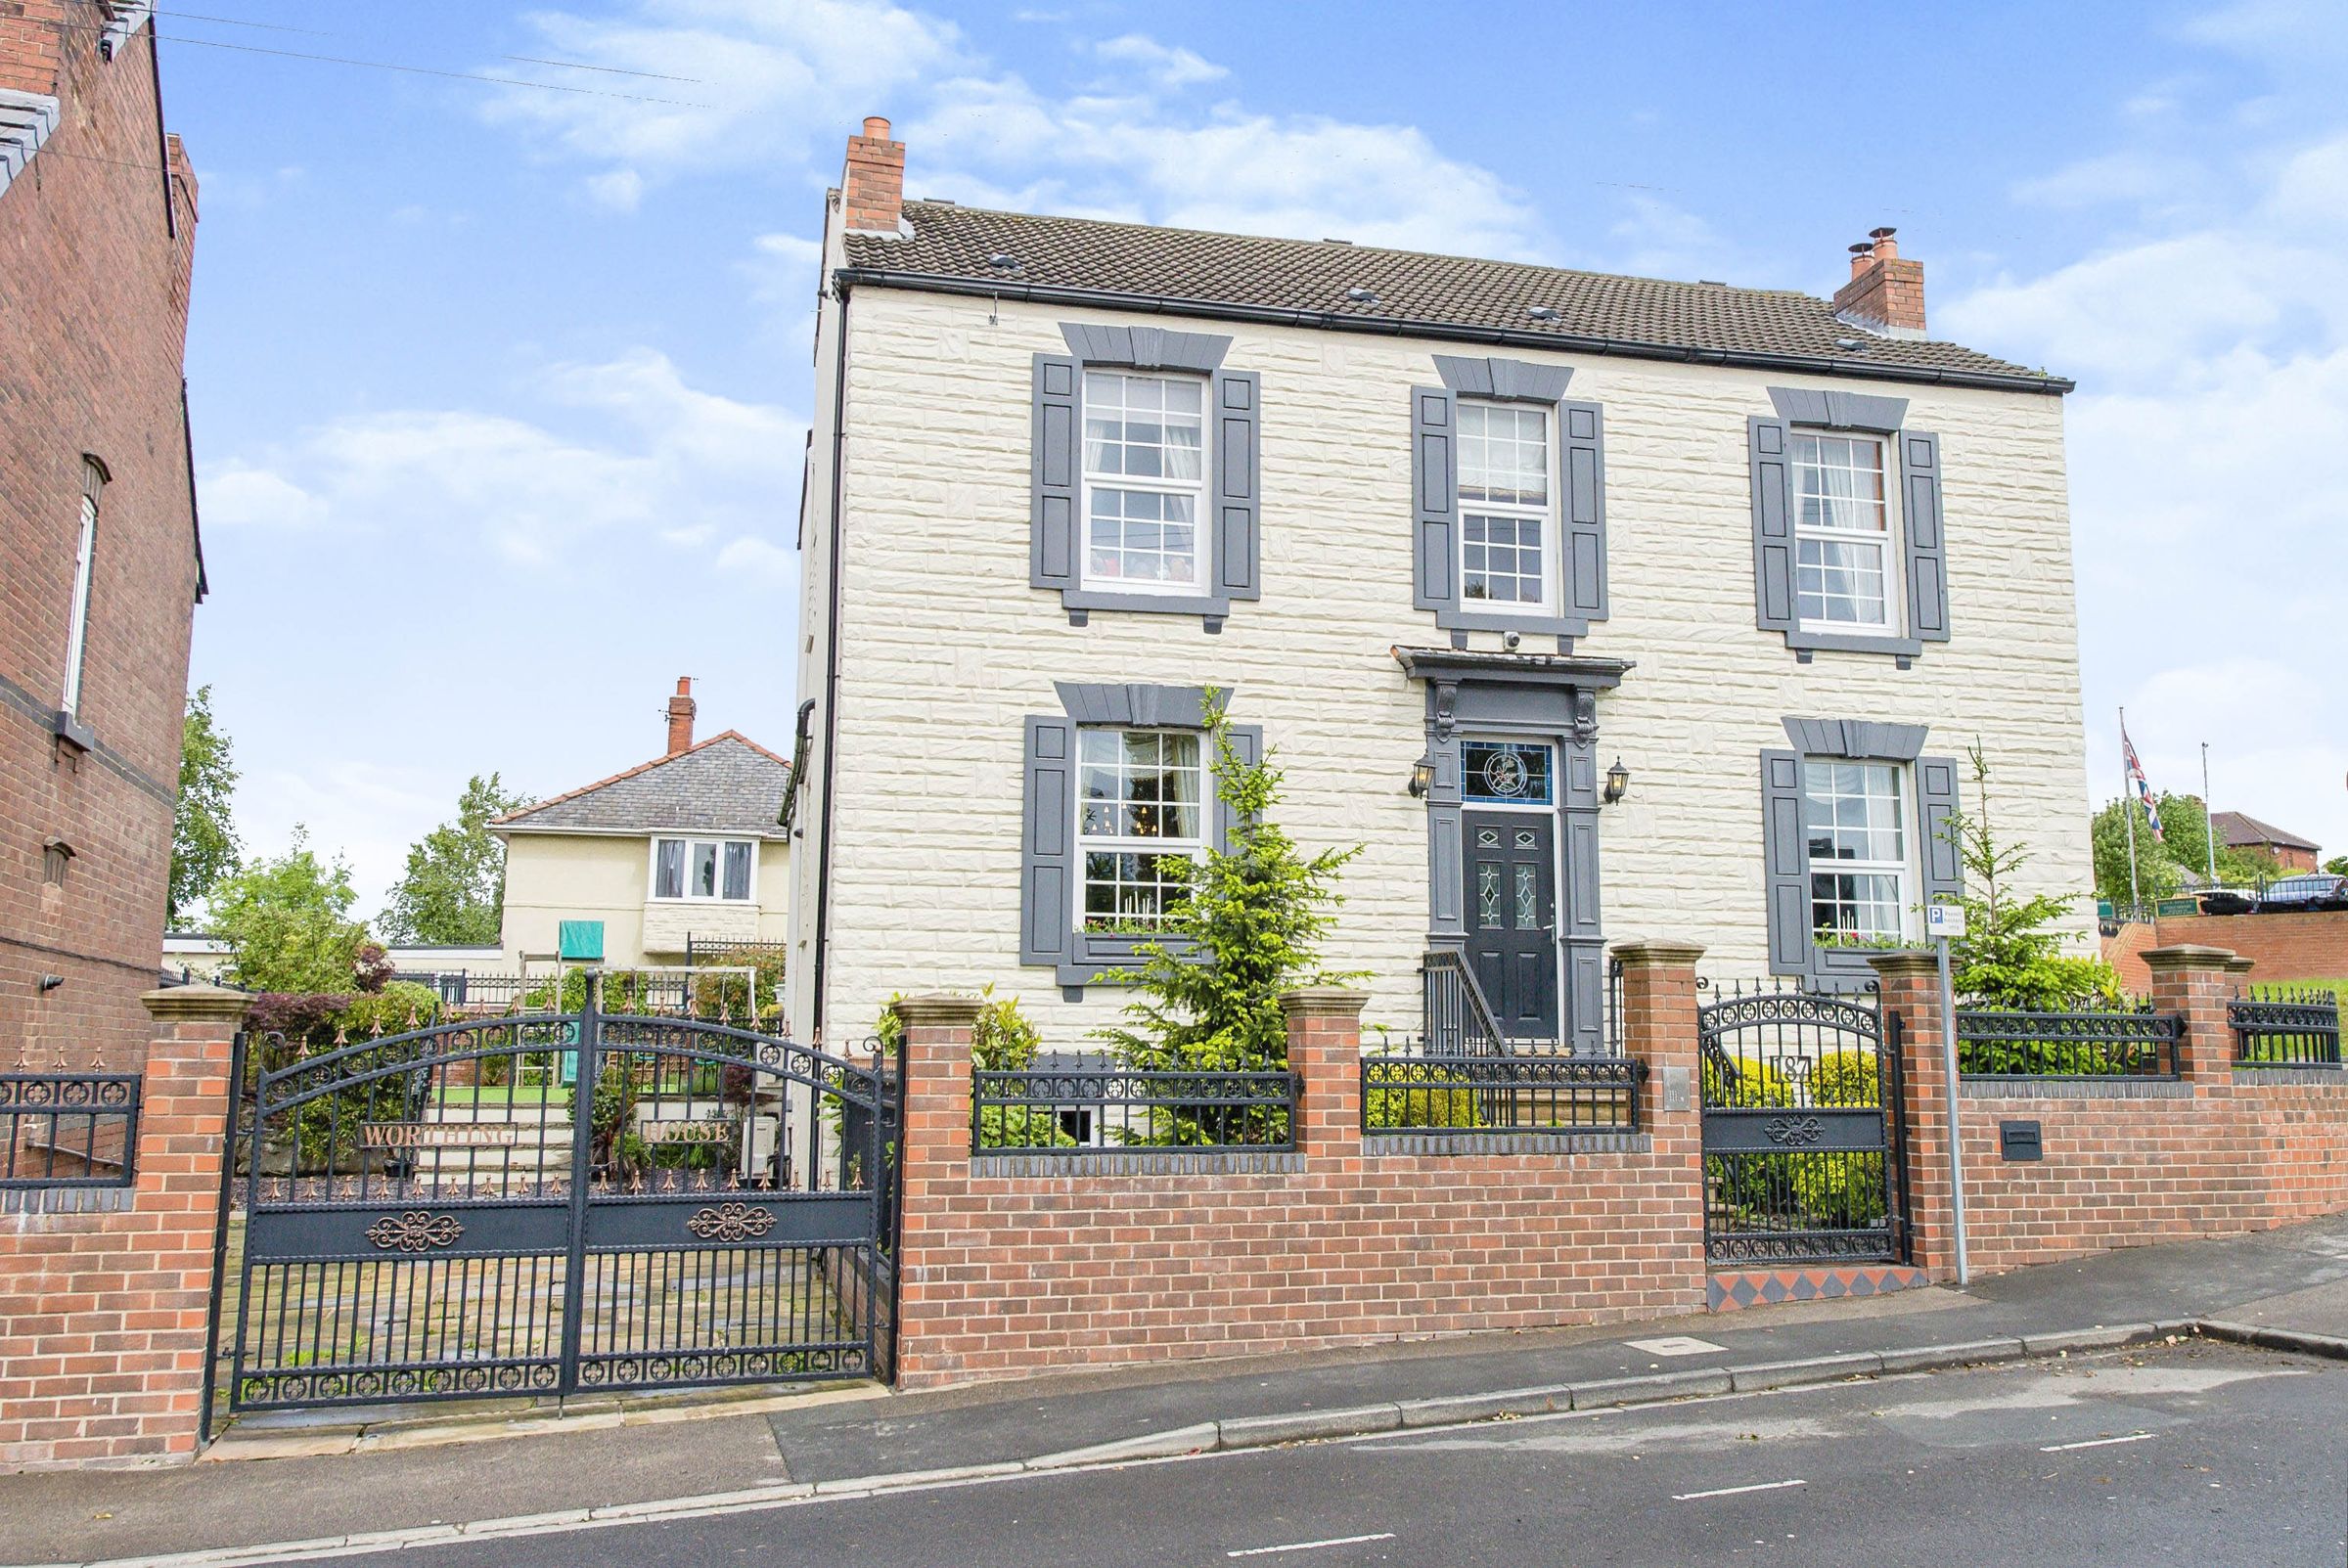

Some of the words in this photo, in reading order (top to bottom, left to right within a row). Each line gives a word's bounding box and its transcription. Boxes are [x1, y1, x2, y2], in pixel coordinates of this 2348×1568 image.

[1931, 909, 1941, 922] P
[1774, 1056, 1809, 1082] 187
[364, 1125, 515, 1145] WORTHING
[645, 1121, 730, 1142] HOUSE
